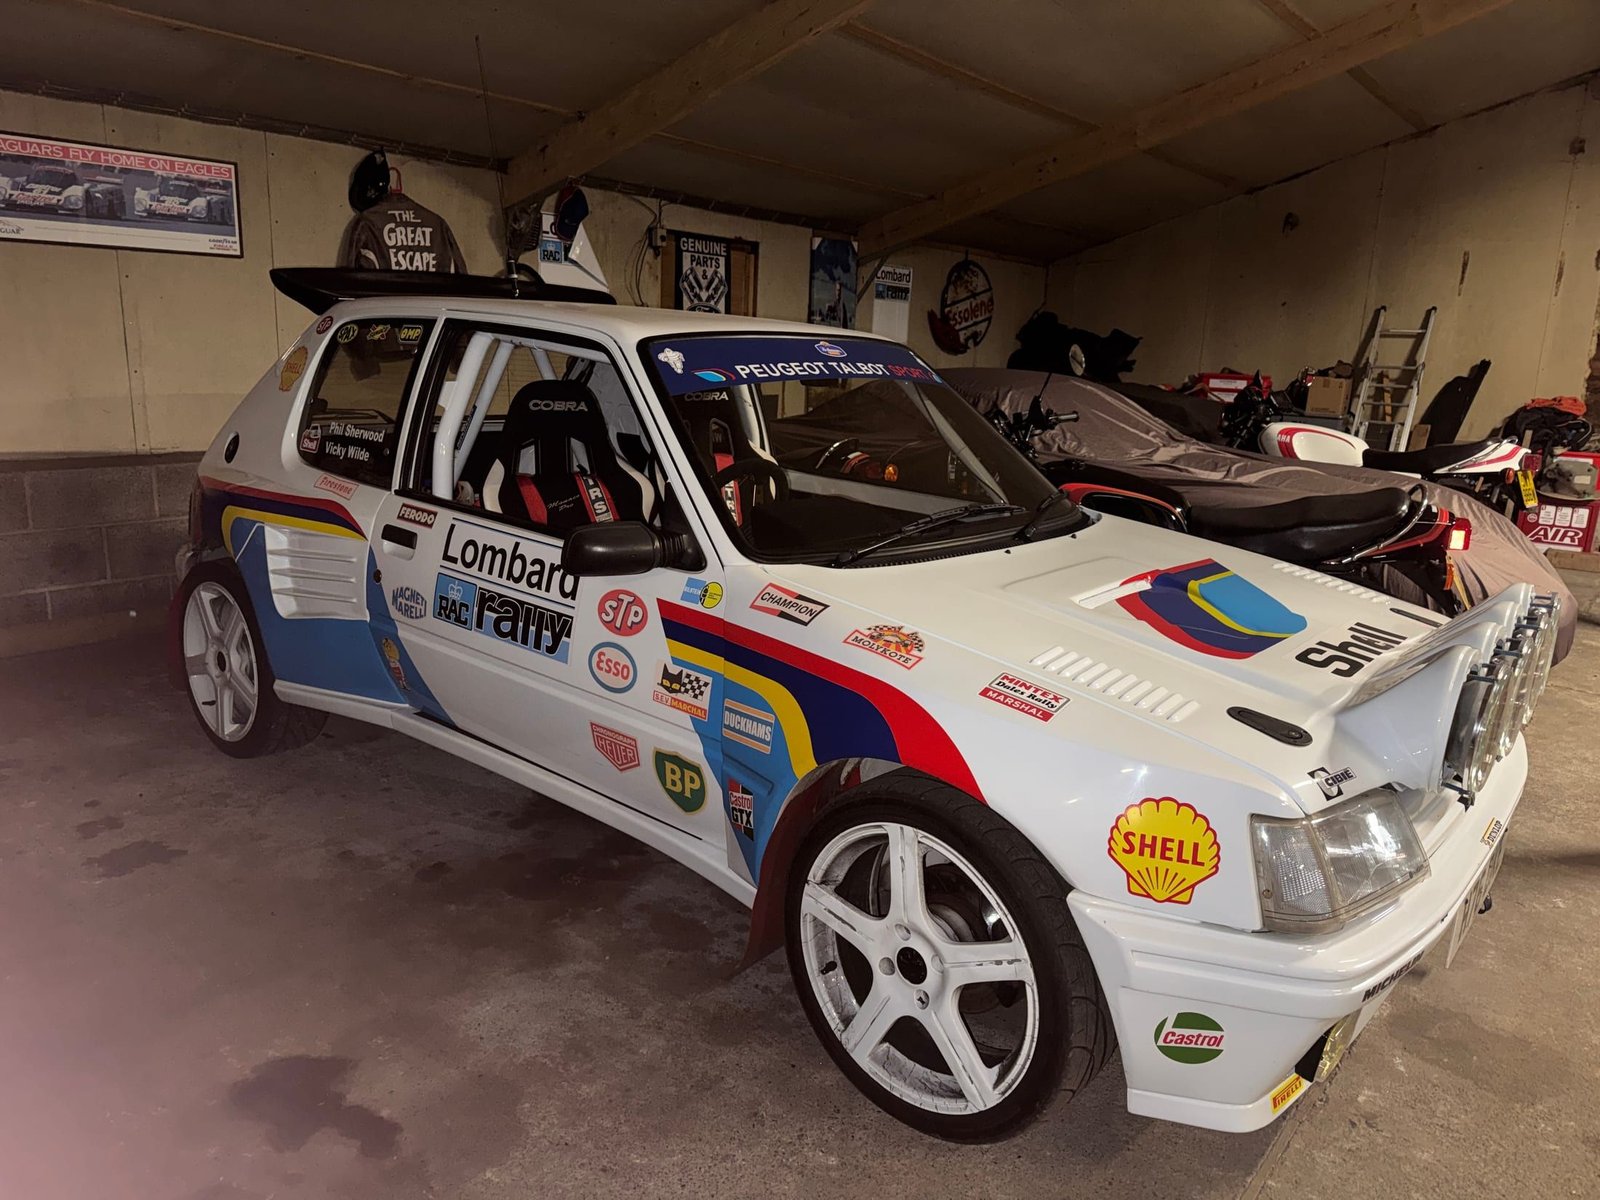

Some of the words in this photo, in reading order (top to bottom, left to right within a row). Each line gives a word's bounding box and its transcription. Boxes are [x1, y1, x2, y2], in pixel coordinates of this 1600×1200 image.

[0, 140, 63, 157] AGUARS
[69, 148, 95, 161] FLY
[101, 152, 145, 168] HOME
[149, 158, 170, 171] ON
[175, 162, 230, 178] EAGLES
[388, 210, 421, 222] THE
[383, 223, 433, 246] GREAT
[543, 249, 560, 262] RAC
[680, 237, 727, 256] GENUINE
[389, 249, 436, 272] ESCAPE
[690, 254, 720, 269] PARTS
[702, 269, 708, 280] &
[401, 328, 421, 339] OMP
[735, 361, 829, 379] PEUGEOT
[828, 361, 890, 376] TALBOT
[887, 364, 929, 379] SPORT
[529, 400, 588, 411] COBRA
[684, 391, 729, 401] COBRA
[303, 438, 318, 450] Shell
[329, 422, 345, 436] Phil
[345, 424, 386, 443] Sherwood
[325, 441, 347, 460] Vicky
[348, 445, 370, 462] Wilde
[319, 476, 353, 495] Firestone
[399, 508, 435, 525] FERODO
[1527, 525, 1584, 545] AIR
[442, 523, 580, 601] Lombard
[601, 594, 643, 630] STP
[761, 592, 817, 617] CHAMPION
[438, 595, 469, 626] RAC
[476, 588, 572, 655] rally
[851, 635, 912, 665] MOLYKOTE
[1295, 622, 1408, 678] Shell
[596, 651, 630, 680] ESSO
[995, 681, 1025, 695] Dales
[1027, 693, 1057, 709] Rally
[1000, 675, 1063, 704] MINTEX
[655, 691, 669, 704] SEV
[671, 698, 706, 719] MARCHAL
[986, 690, 1044, 718] MARSHAL
[725, 710, 771, 741] DUCKHAMS
[597, 736, 635, 765] HEUER
[664, 761, 700, 798] BP
[729, 791, 752, 810] Castrol
[731, 808, 752, 827] GTX
[1122, 831, 1206, 867] SHELL
[1162, 1031, 1225, 1047] Castrol
[1272, 1076, 1302, 1110] PIRELLI
